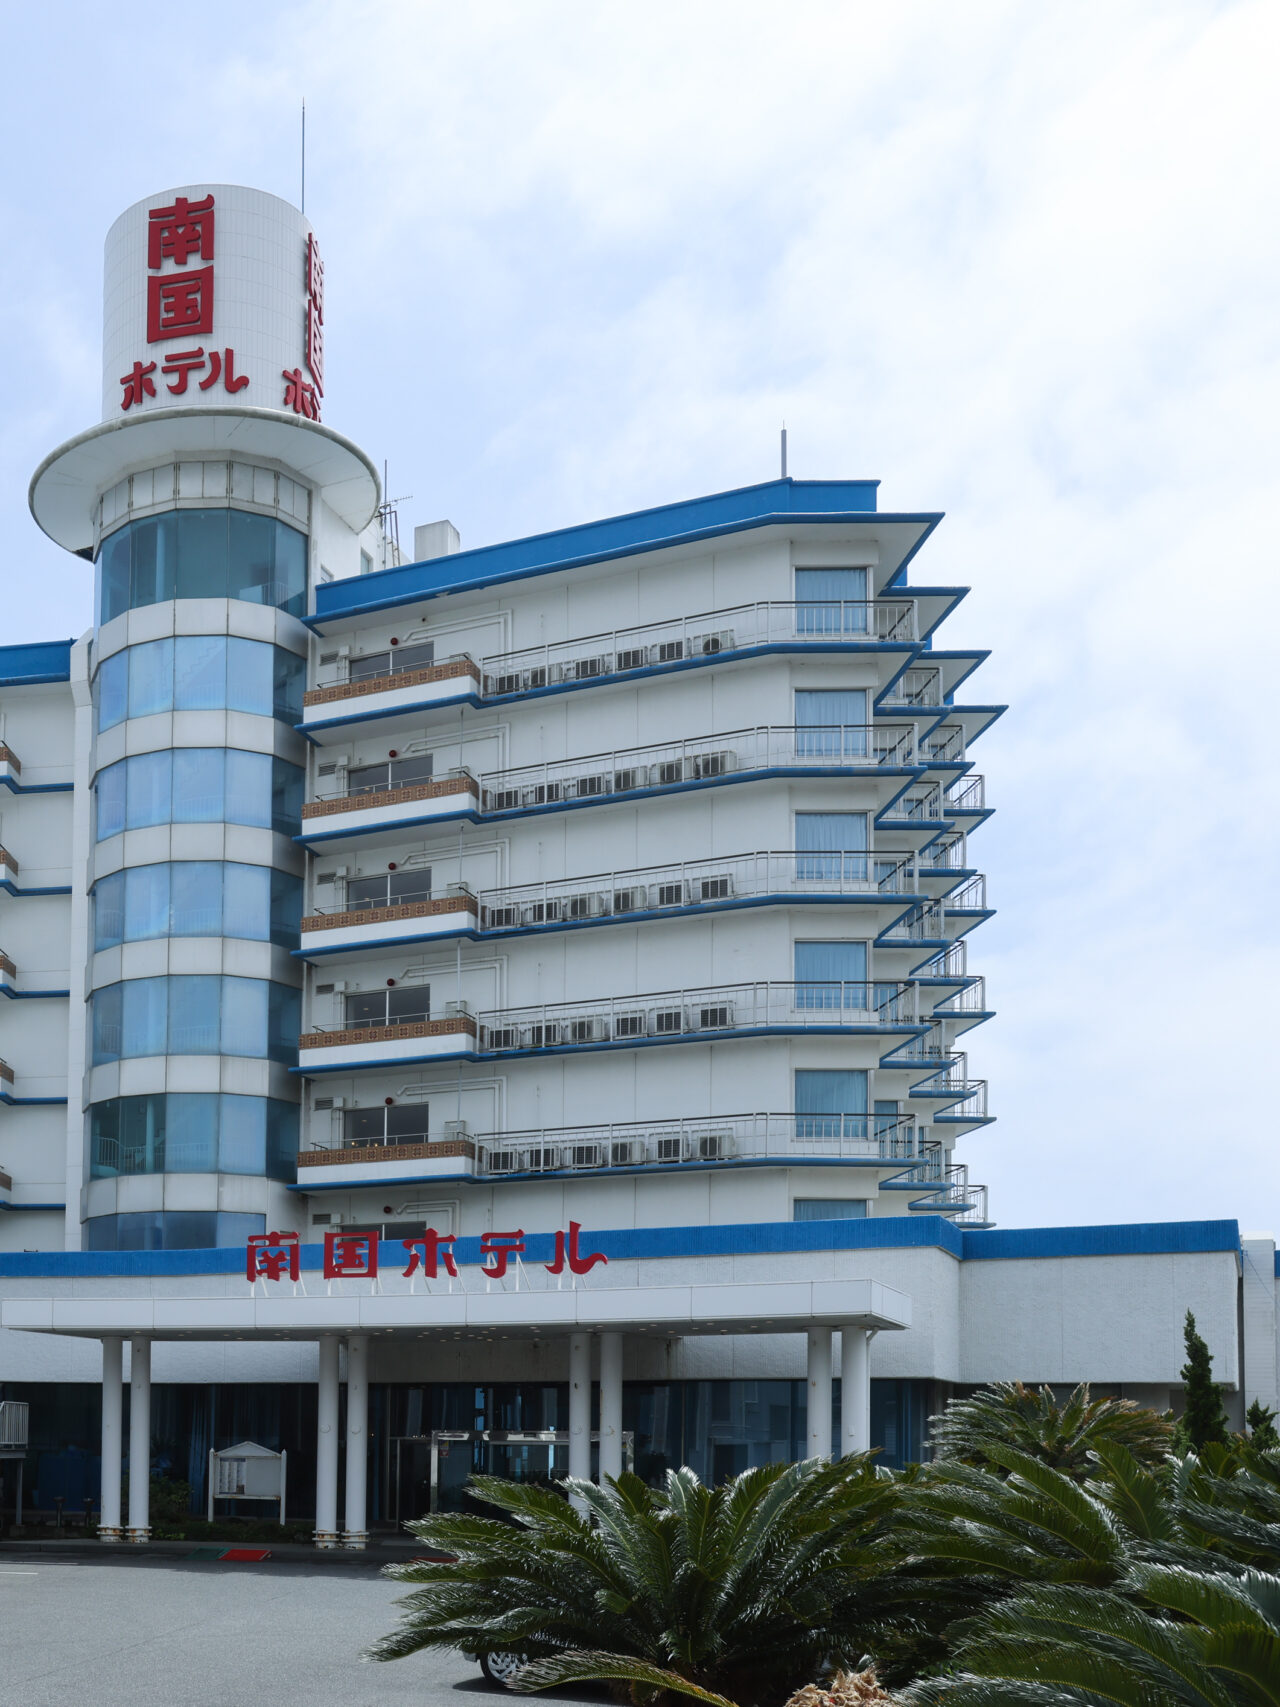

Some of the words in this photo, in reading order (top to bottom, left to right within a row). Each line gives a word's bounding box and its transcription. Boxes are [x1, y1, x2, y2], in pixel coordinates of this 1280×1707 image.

[147, 194, 215, 344] 南国
[120, 347, 250, 411] ホテル
[246, 1220, 608, 1282] 南国ホテル
